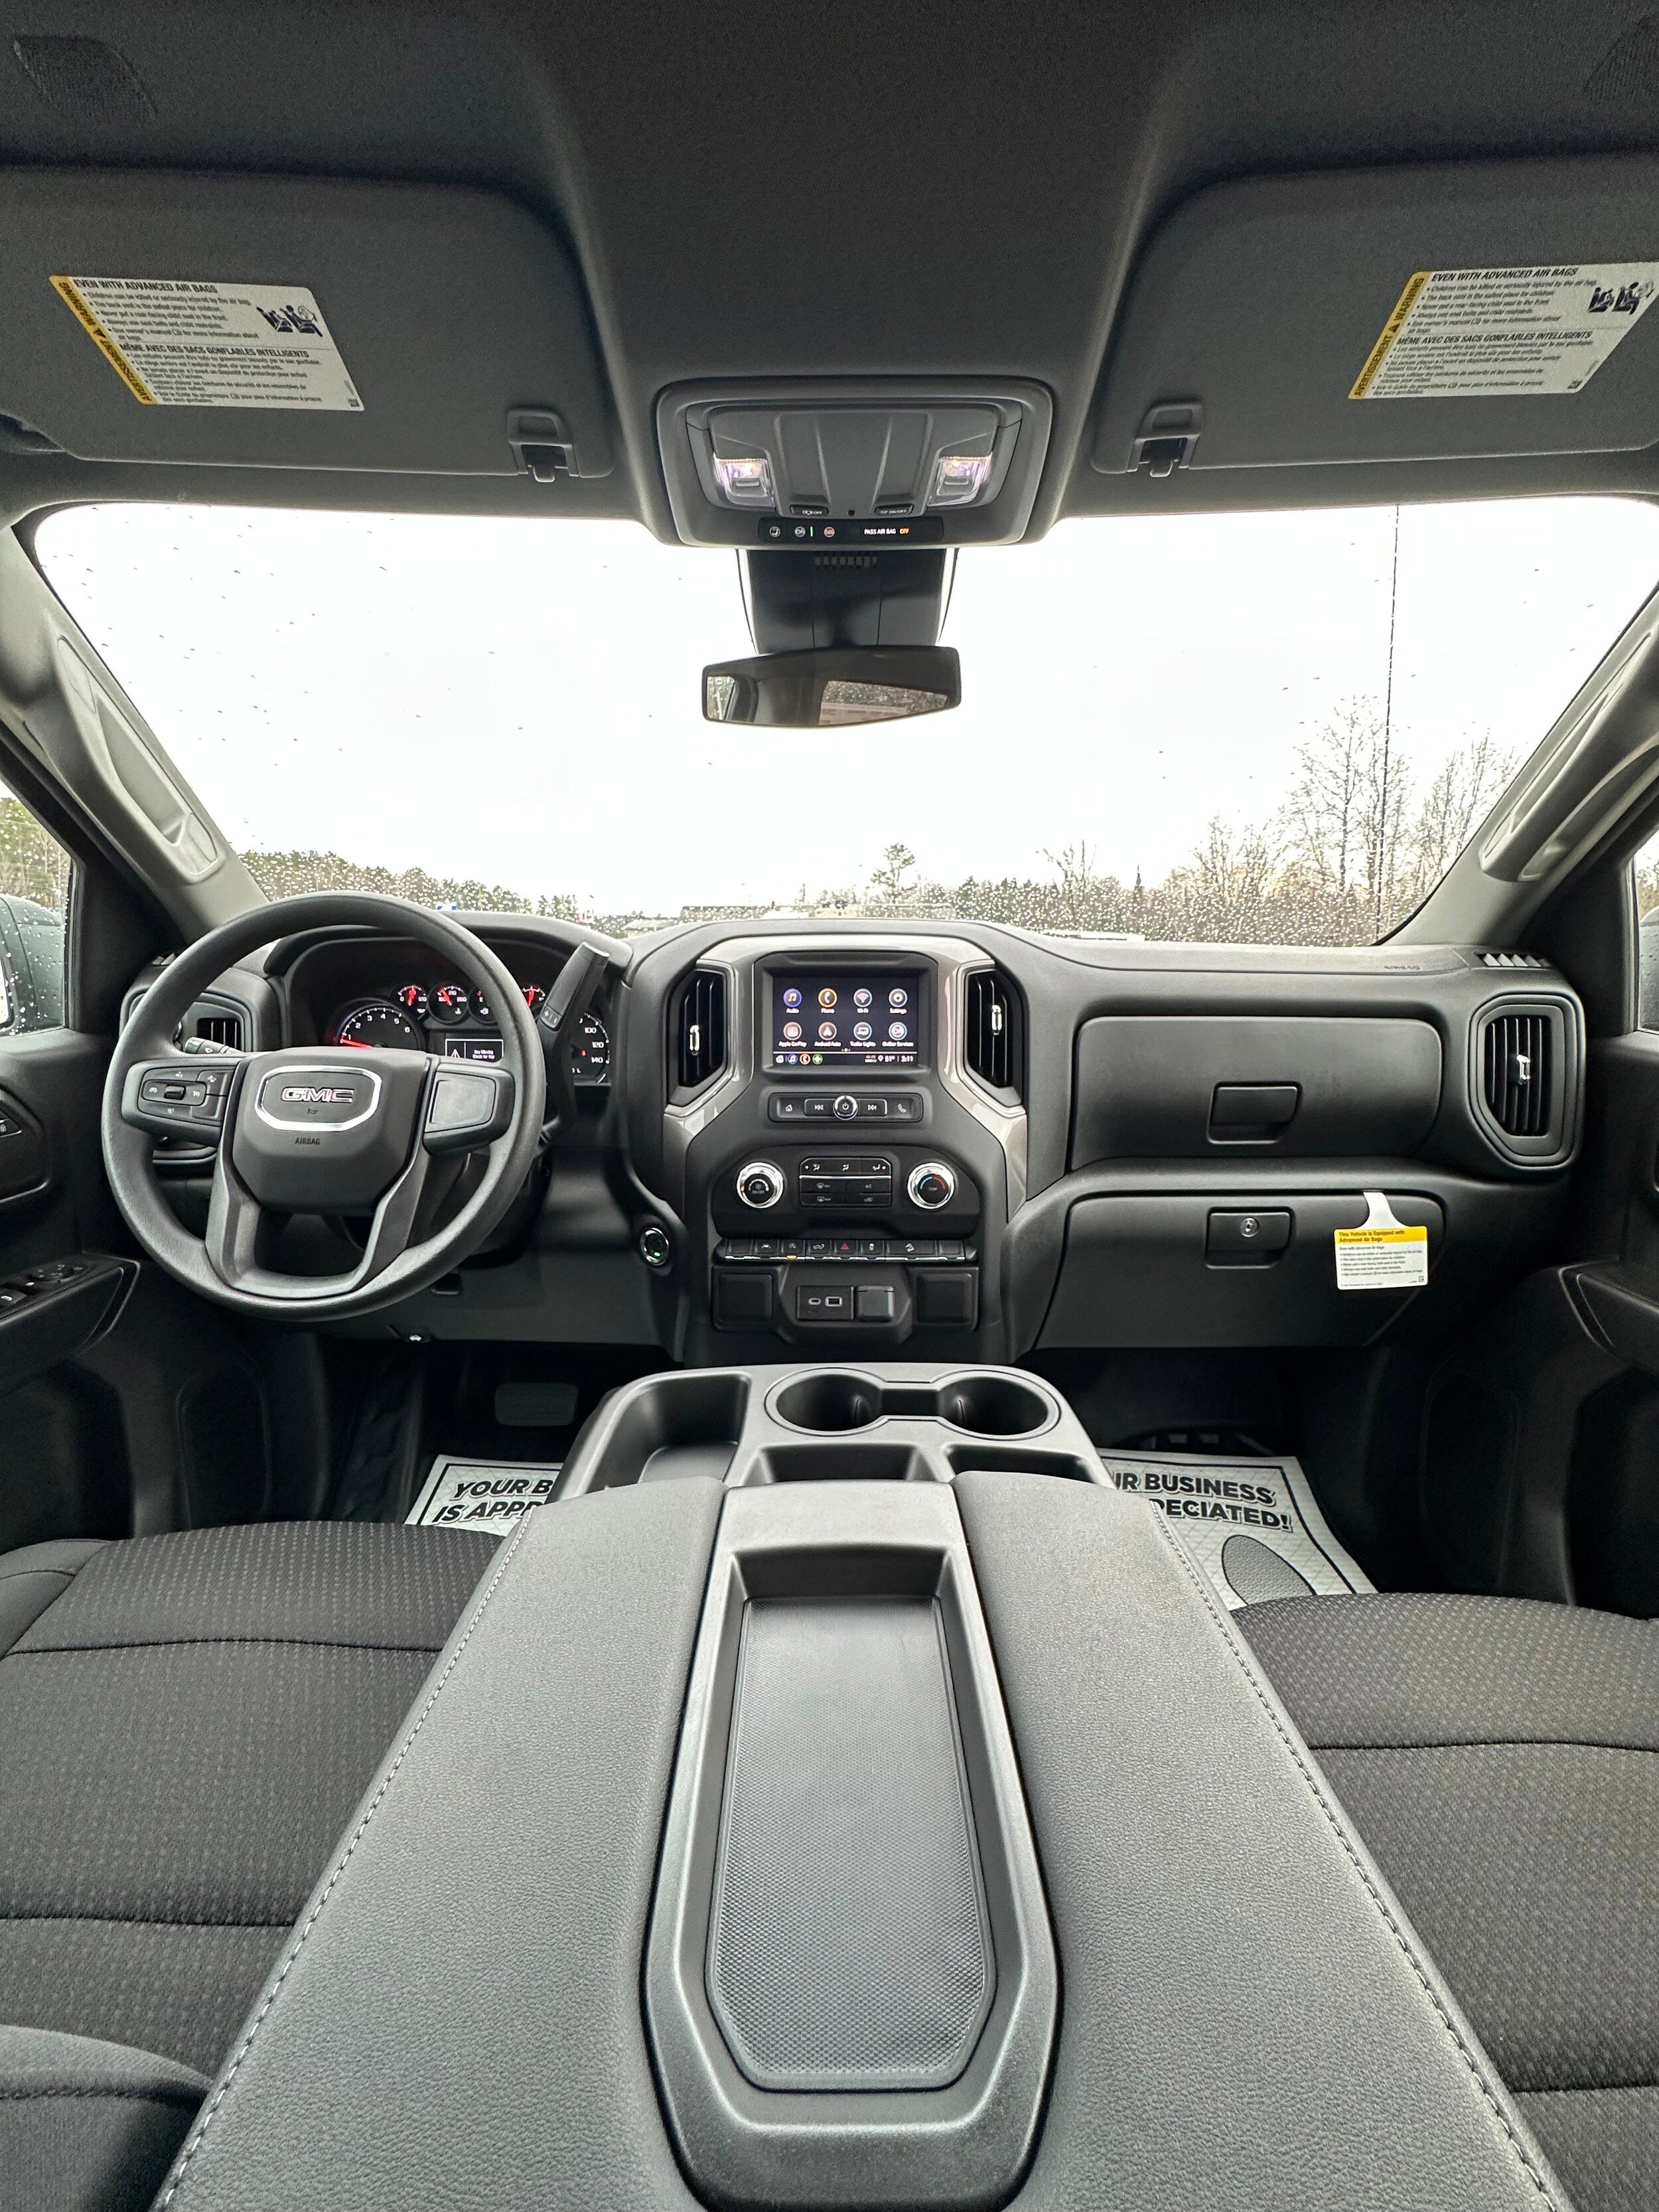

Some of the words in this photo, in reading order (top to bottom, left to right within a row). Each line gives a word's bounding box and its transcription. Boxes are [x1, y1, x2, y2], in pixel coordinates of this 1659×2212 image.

[1431, 273, 1456, 281] EVEN
[1457, 271, 1482, 281] WITH
[1481, 269, 1532, 279] ADVANCED
[1532, 269, 1551, 277] AIR
[1551, 267, 1579, 276] BAGS
[74, 279, 99, 288] EVEN
[99, 280, 124, 289] WITH
[124, 281, 173, 291] ADVANCED
[59, 282, 96, 326] WARNING
[1394, 277, 1424, 322] WARNING
[1484, 333, 1536, 342] GONFLABLES
[206, 346, 256, 356] GONFLABLES
[256, 348, 309, 358] INTELLIGENTS
[100, 339, 151, 401] AVERTISSEMENT
[1354, 334, 1393, 396] AVERTISSEMENT
[282, 1087, 354, 1102] GMC
[454, 1479, 530, 1499] YOUR
[1145, 1473, 1275, 1505] BUSINESS
[433, 1504, 465, 1522] IS
